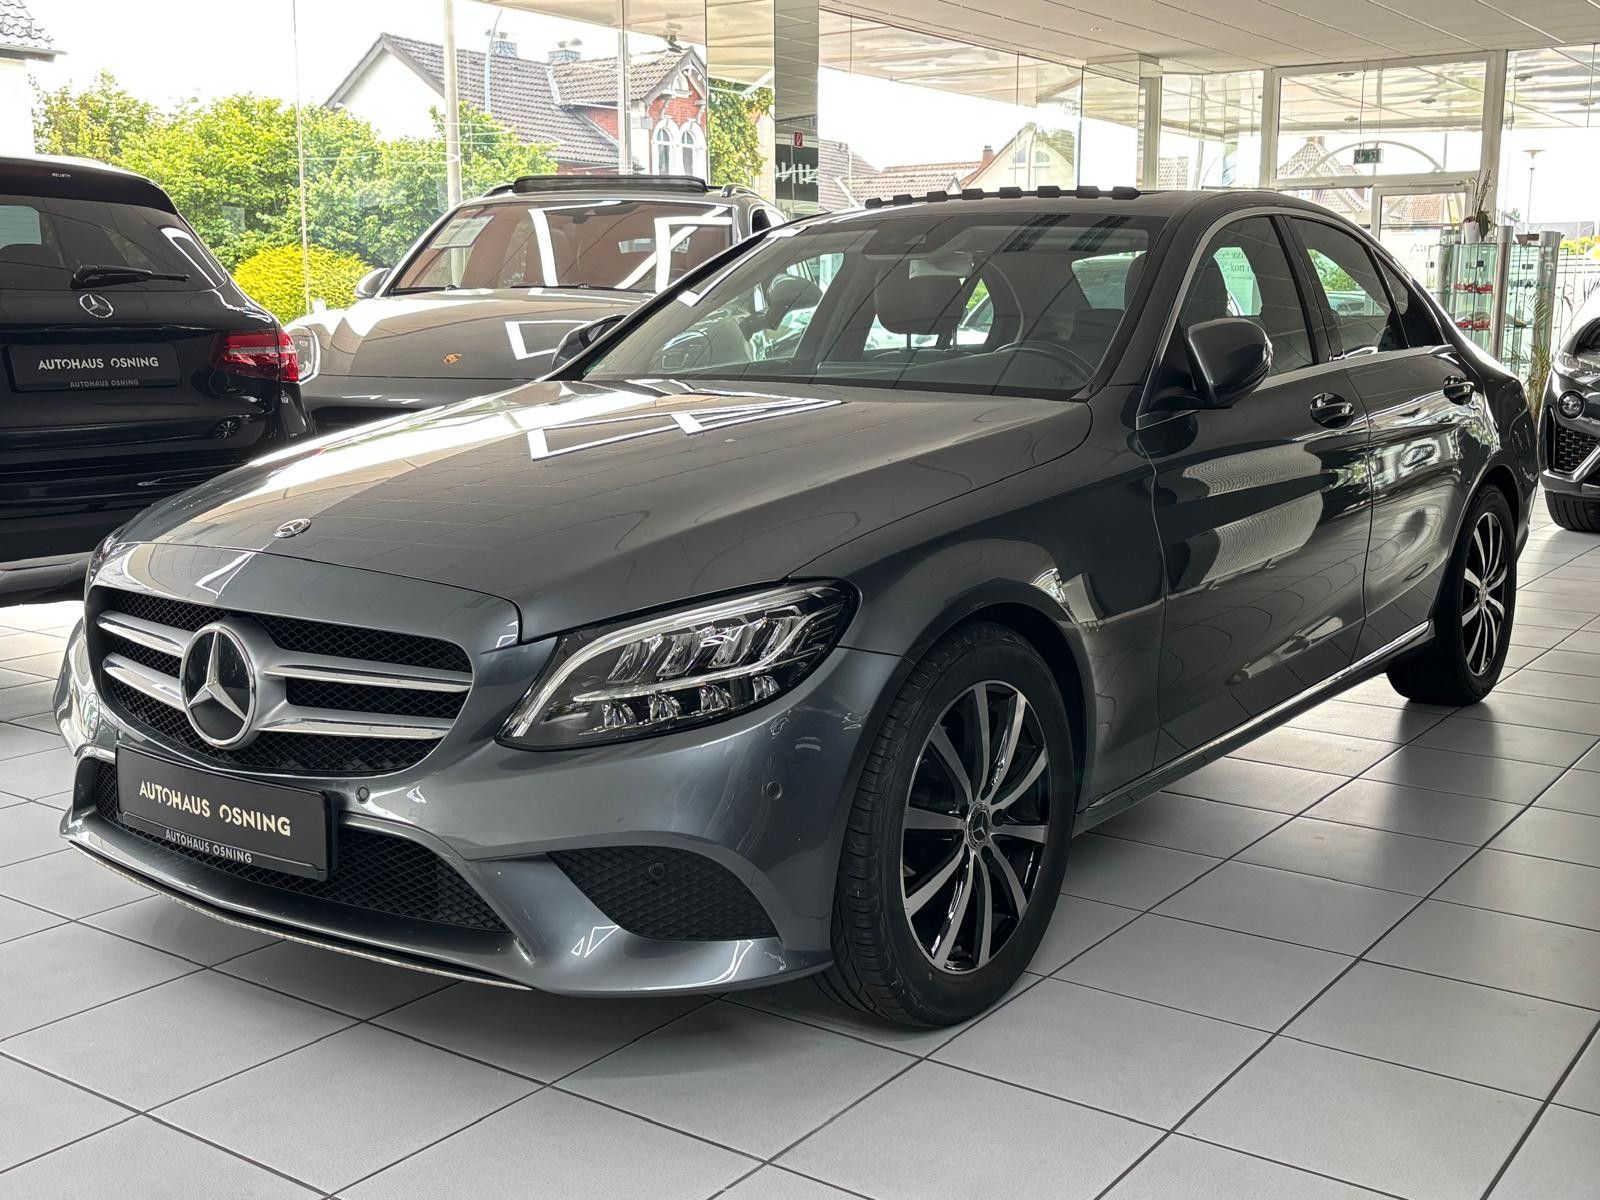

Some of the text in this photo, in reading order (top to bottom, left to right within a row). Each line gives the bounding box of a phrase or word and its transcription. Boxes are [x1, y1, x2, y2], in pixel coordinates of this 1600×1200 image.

[38, 357, 159, 370] AUTOHAUS OSNING
[70, 379, 139, 388] AUTOHAUS OSNING
[139, 780, 291, 836] AUTOHAUS OSNING
[165, 829, 252, 864] AUTOHAUS OSNING
